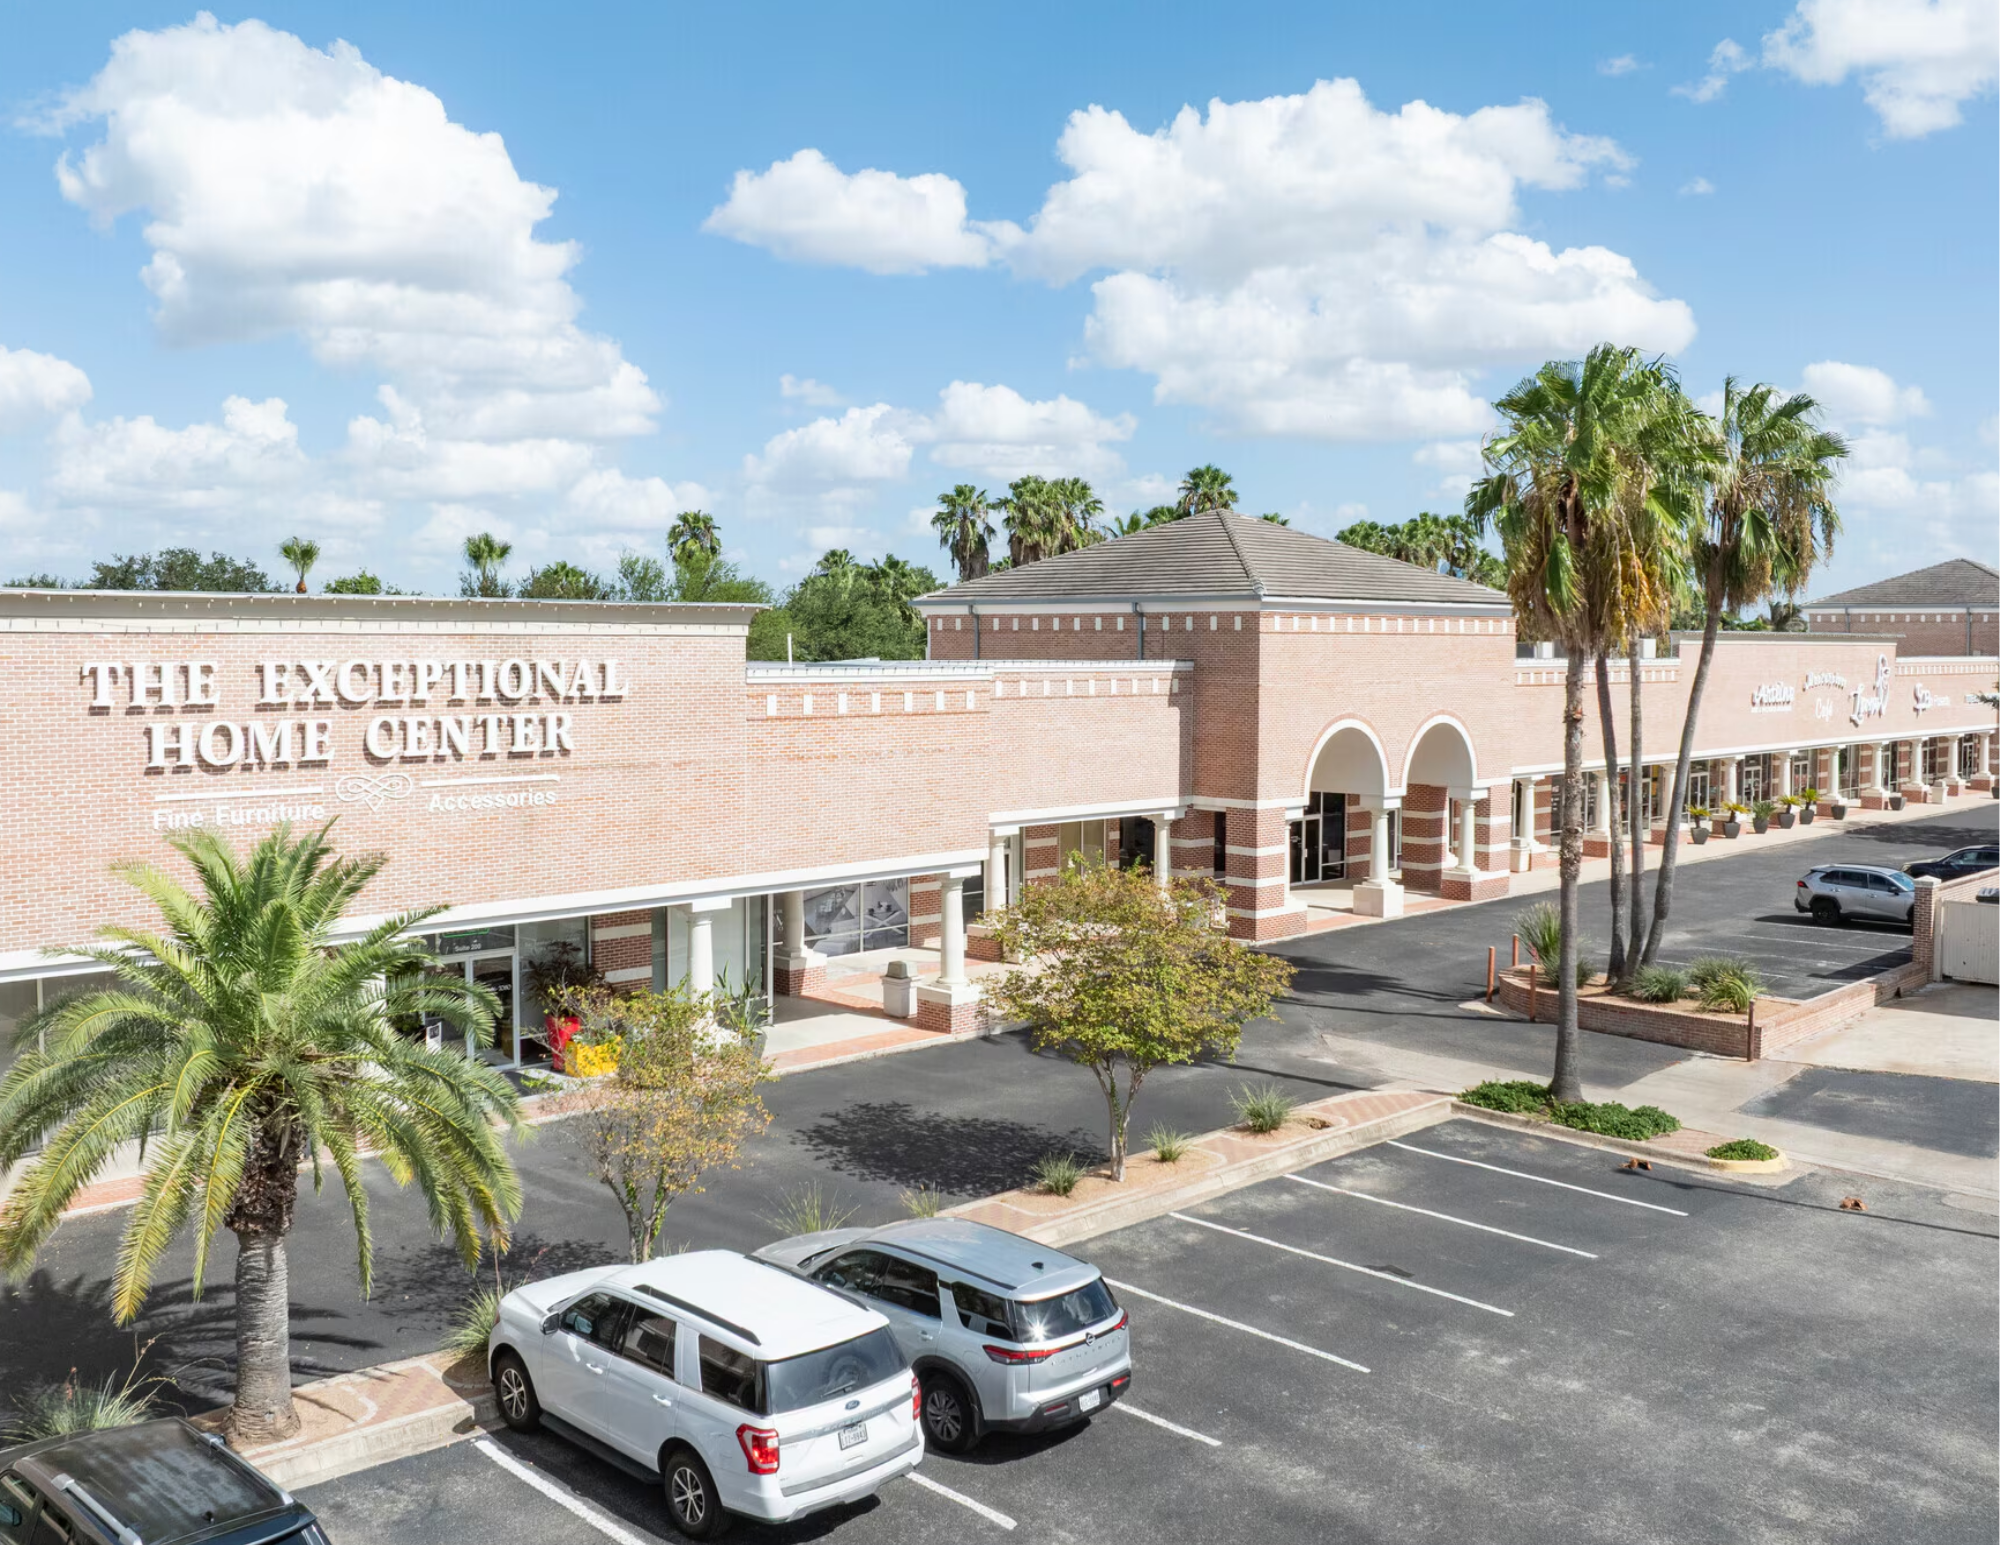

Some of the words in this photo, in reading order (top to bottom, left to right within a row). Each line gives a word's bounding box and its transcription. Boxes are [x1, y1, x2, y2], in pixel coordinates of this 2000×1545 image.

[82, 660, 221, 706] THE
[259, 658, 629, 704] EXCEPTIONAL
[147, 719, 336, 767] HOME
[365, 712, 576, 759] CENTER
[152, 808, 204, 831] Fine
[215, 802, 325, 827] Furniture
[428, 788, 557, 814] Accessories
